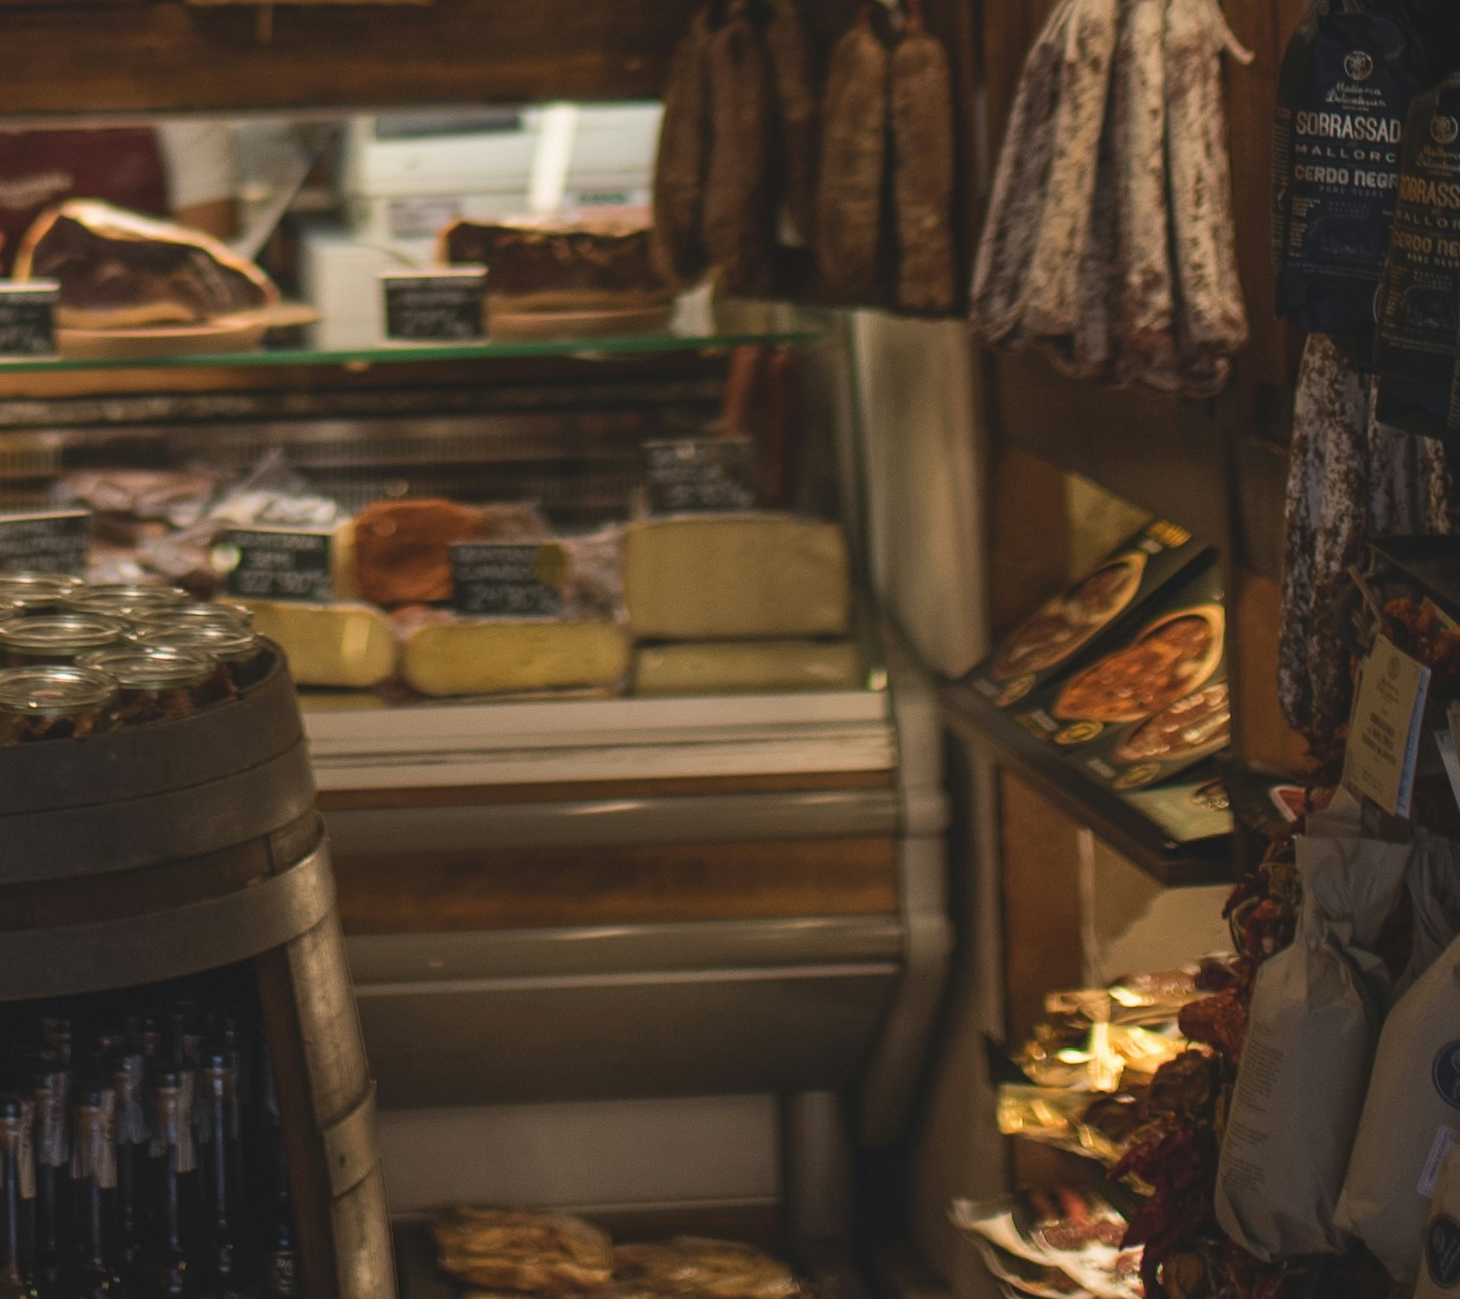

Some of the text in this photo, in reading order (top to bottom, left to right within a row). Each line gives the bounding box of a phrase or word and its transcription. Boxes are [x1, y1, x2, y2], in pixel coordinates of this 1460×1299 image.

[1295, 109, 1403, 145] SOBRASSAD
[1295, 144, 1398, 165] MALLORC
[1294, 163, 1399, 191] CERDO NEGR
